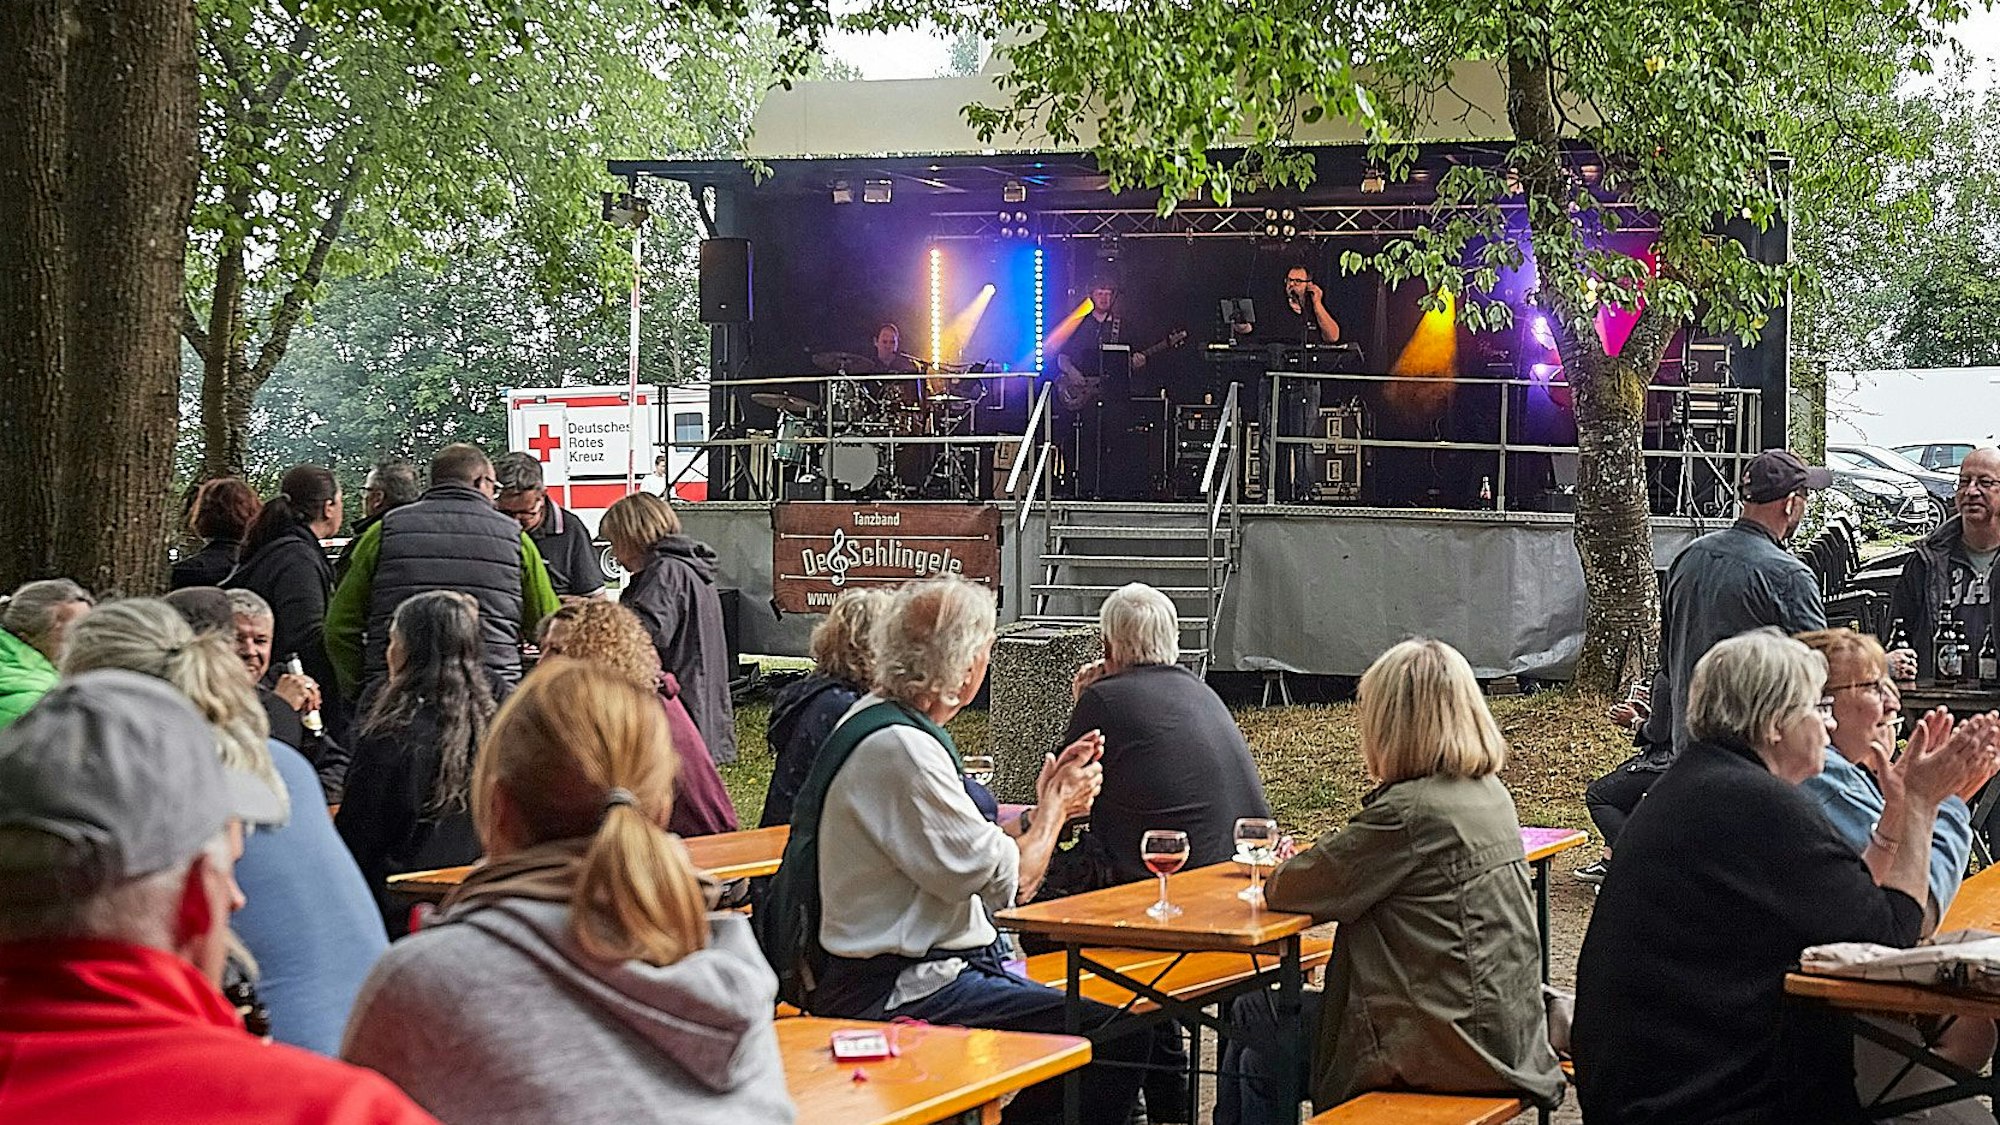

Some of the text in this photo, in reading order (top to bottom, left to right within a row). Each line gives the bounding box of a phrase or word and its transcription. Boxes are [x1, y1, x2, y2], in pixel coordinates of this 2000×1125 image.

[568, 421, 631, 434] Deutsches
[569, 437, 604, 448] Rotes
[569, 451, 605, 462] Kreuz
[853, 511, 900, 526] Tanzband
[801, 538, 963, 577] De Schlingele
